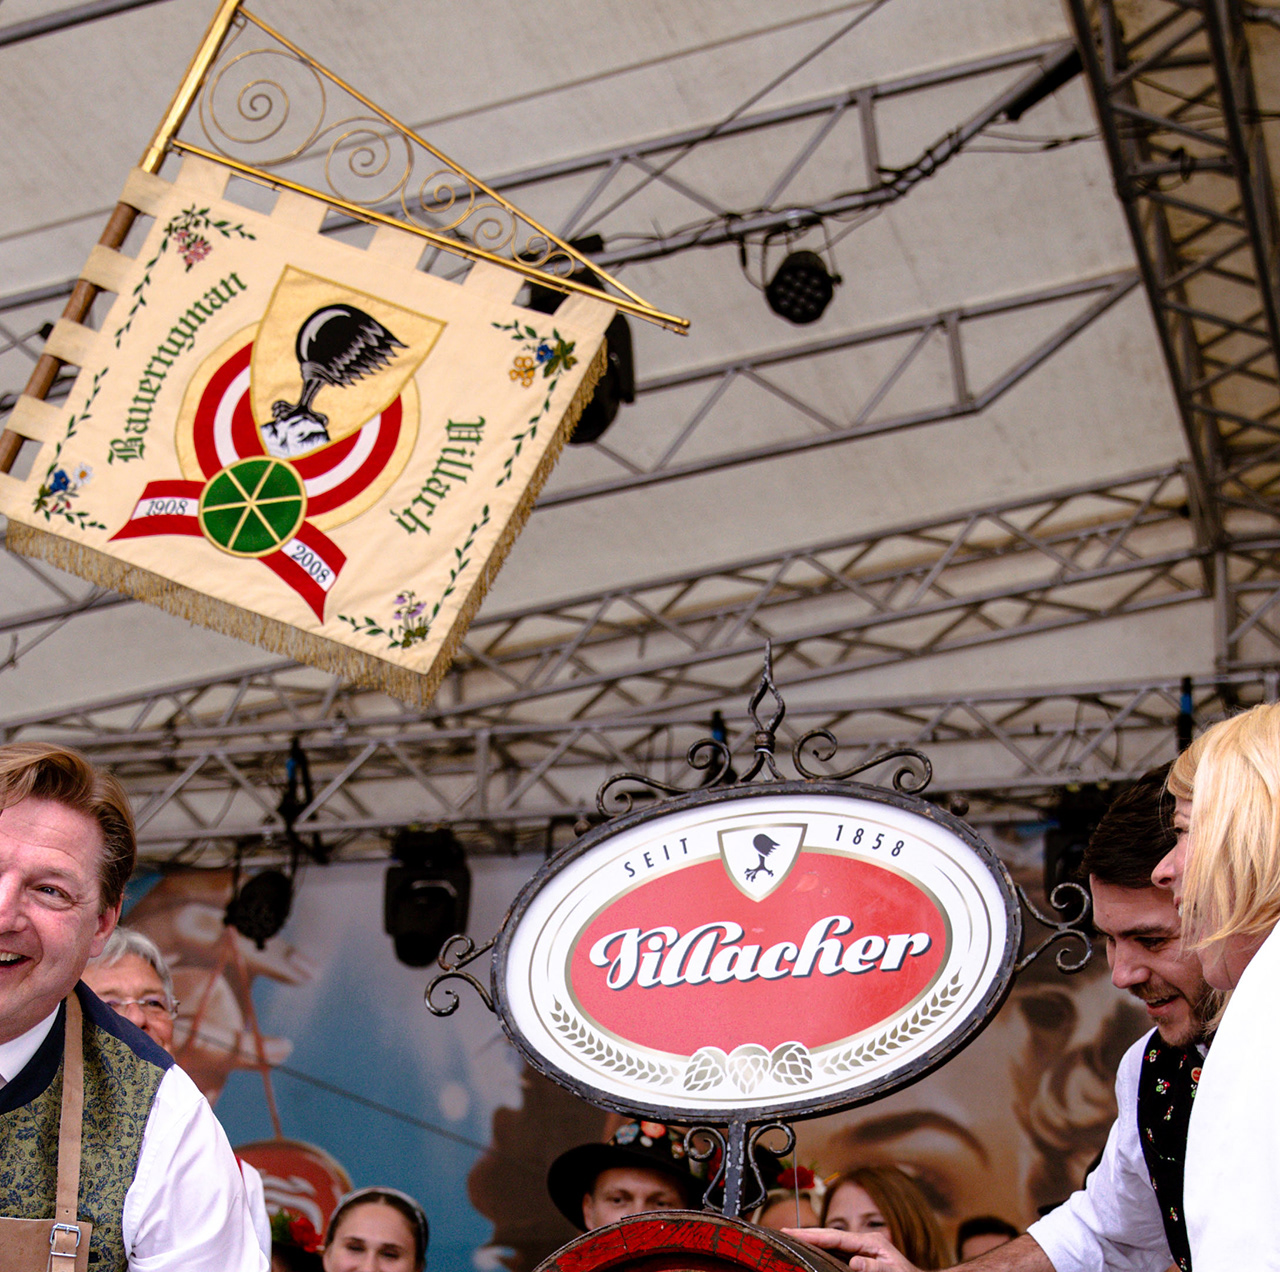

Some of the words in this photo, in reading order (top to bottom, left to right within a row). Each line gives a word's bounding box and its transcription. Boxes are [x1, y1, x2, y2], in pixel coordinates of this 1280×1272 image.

[389, 415, 486, 535] Villach
[146, 500, 189, 516] 1908
[291, 544, 331, 584] 2008
[624, 838, 689, 877] SEIT
[835, 825, 904, 857] 1858
[589, 915, 931, 990] Villacher
